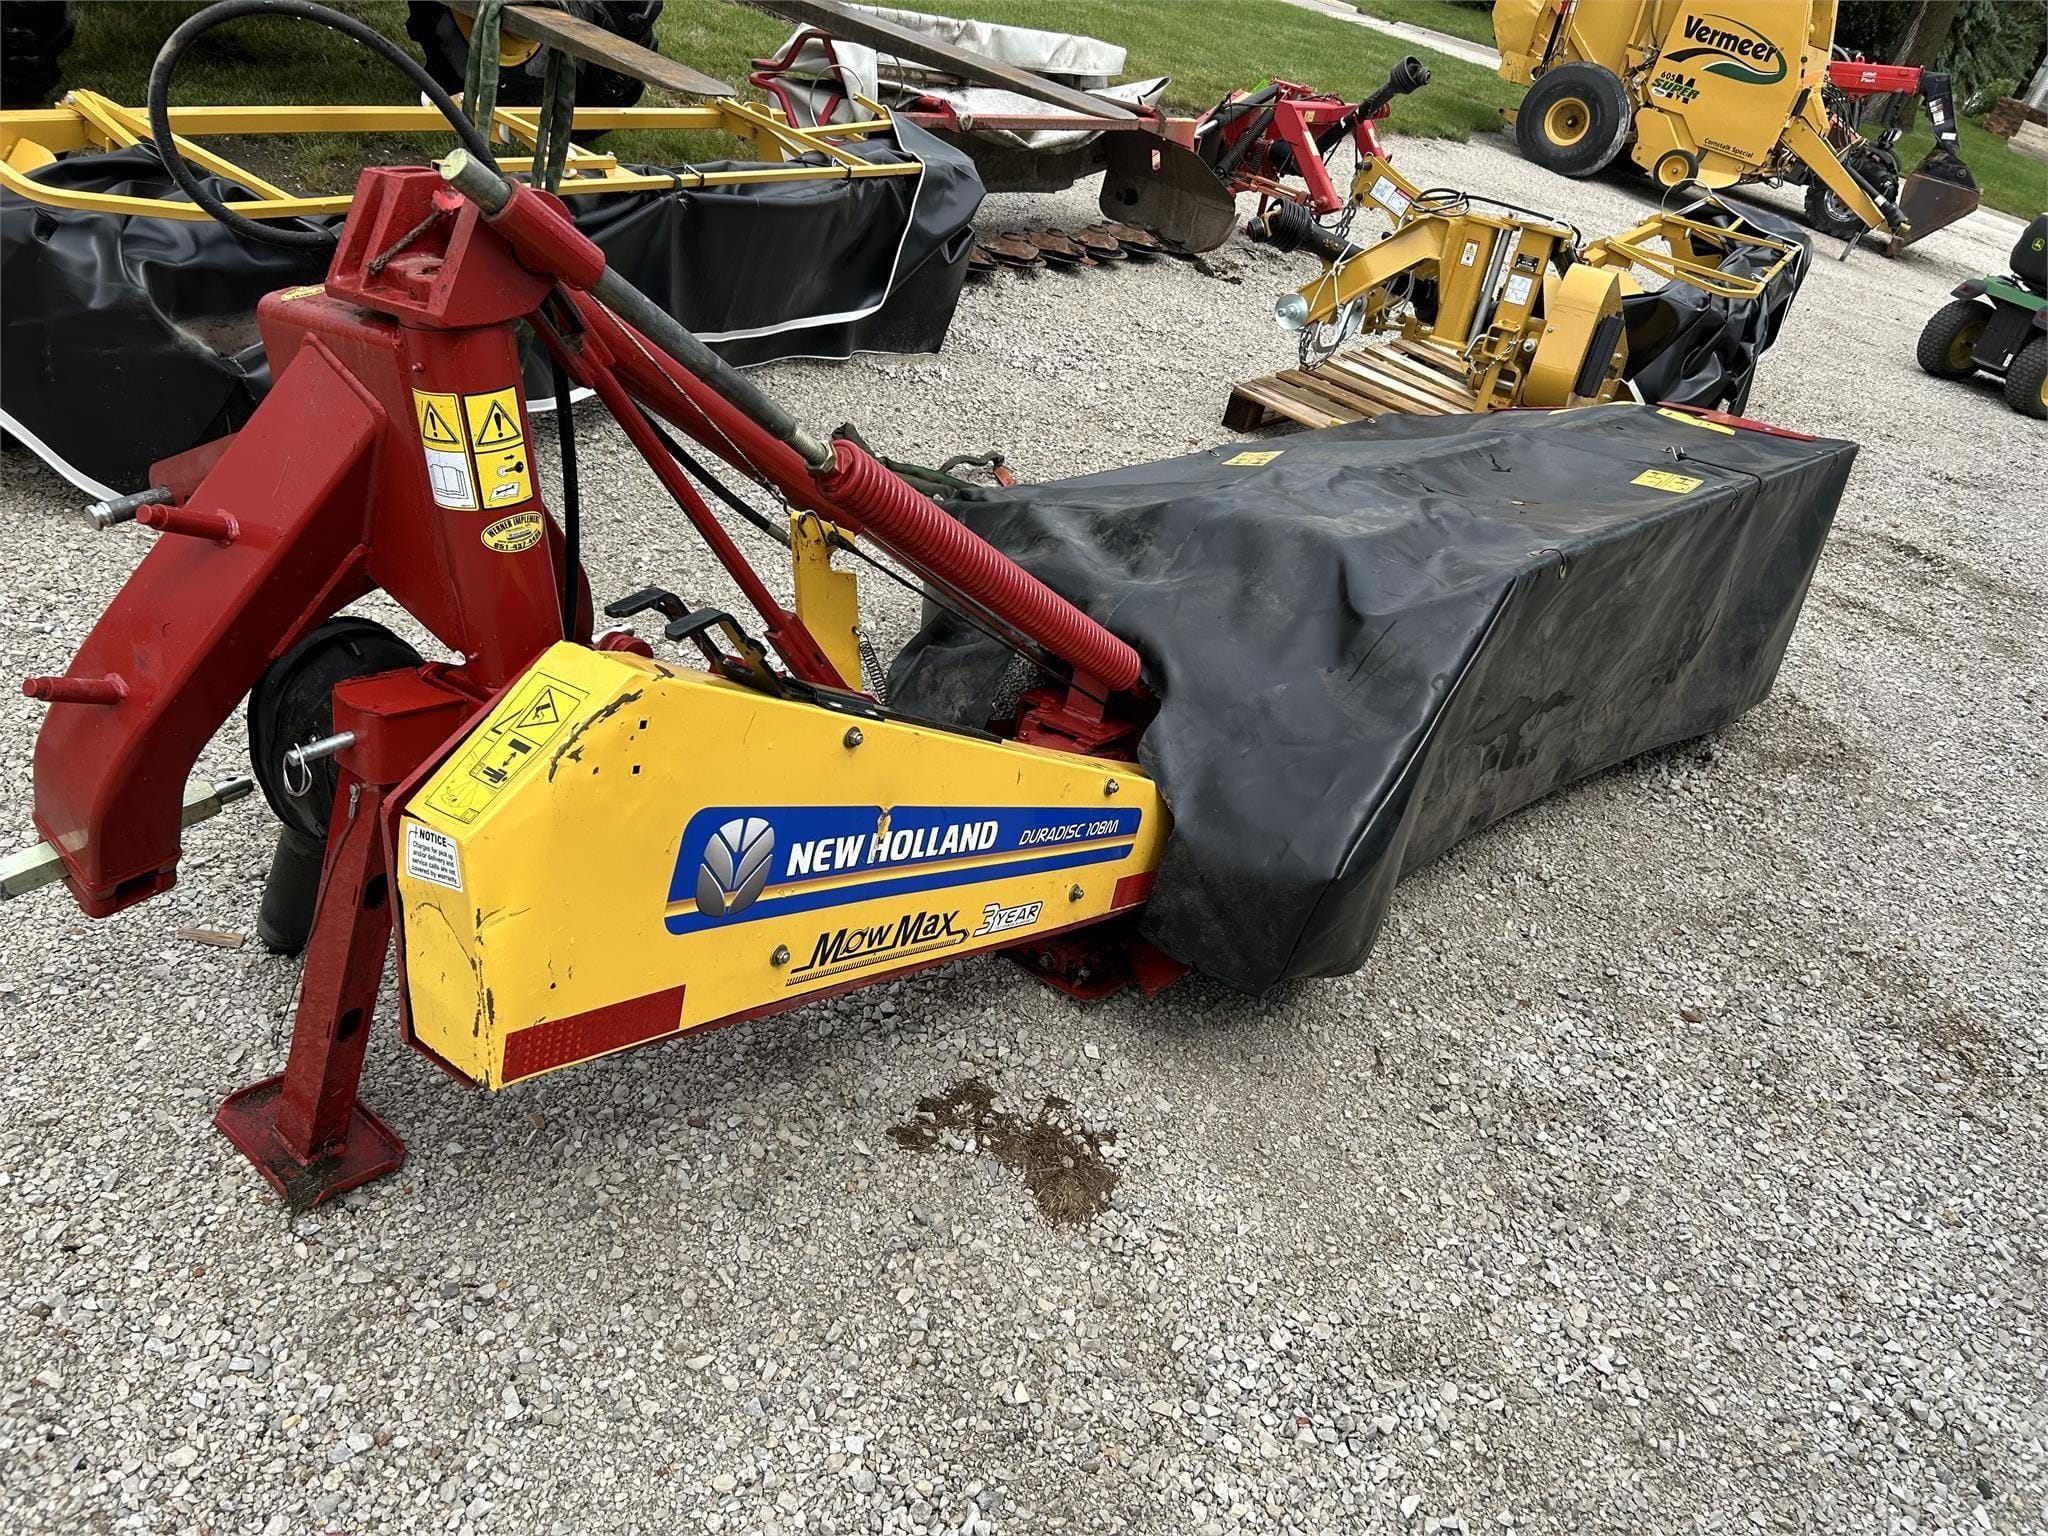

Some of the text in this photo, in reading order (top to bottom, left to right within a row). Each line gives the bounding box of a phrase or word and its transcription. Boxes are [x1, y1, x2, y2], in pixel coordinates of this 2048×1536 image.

[1684, 15, 1778, 62] Vermeer
[1660, 71, 1676, 81] 605
[1651, 78, 1700, 99] SUPER
[1704, 137, 1754, 158] Cornstalk Special
[486, 520, 512, 538] WERNER
[419, 828, 447, 848] NOTICE
[786, 819, 1120, 877] NEW HOLLAND DURADISC 108M
[997, 905, 1039, 926] YEAR
[798, 910, 961, 971] Mow Max
